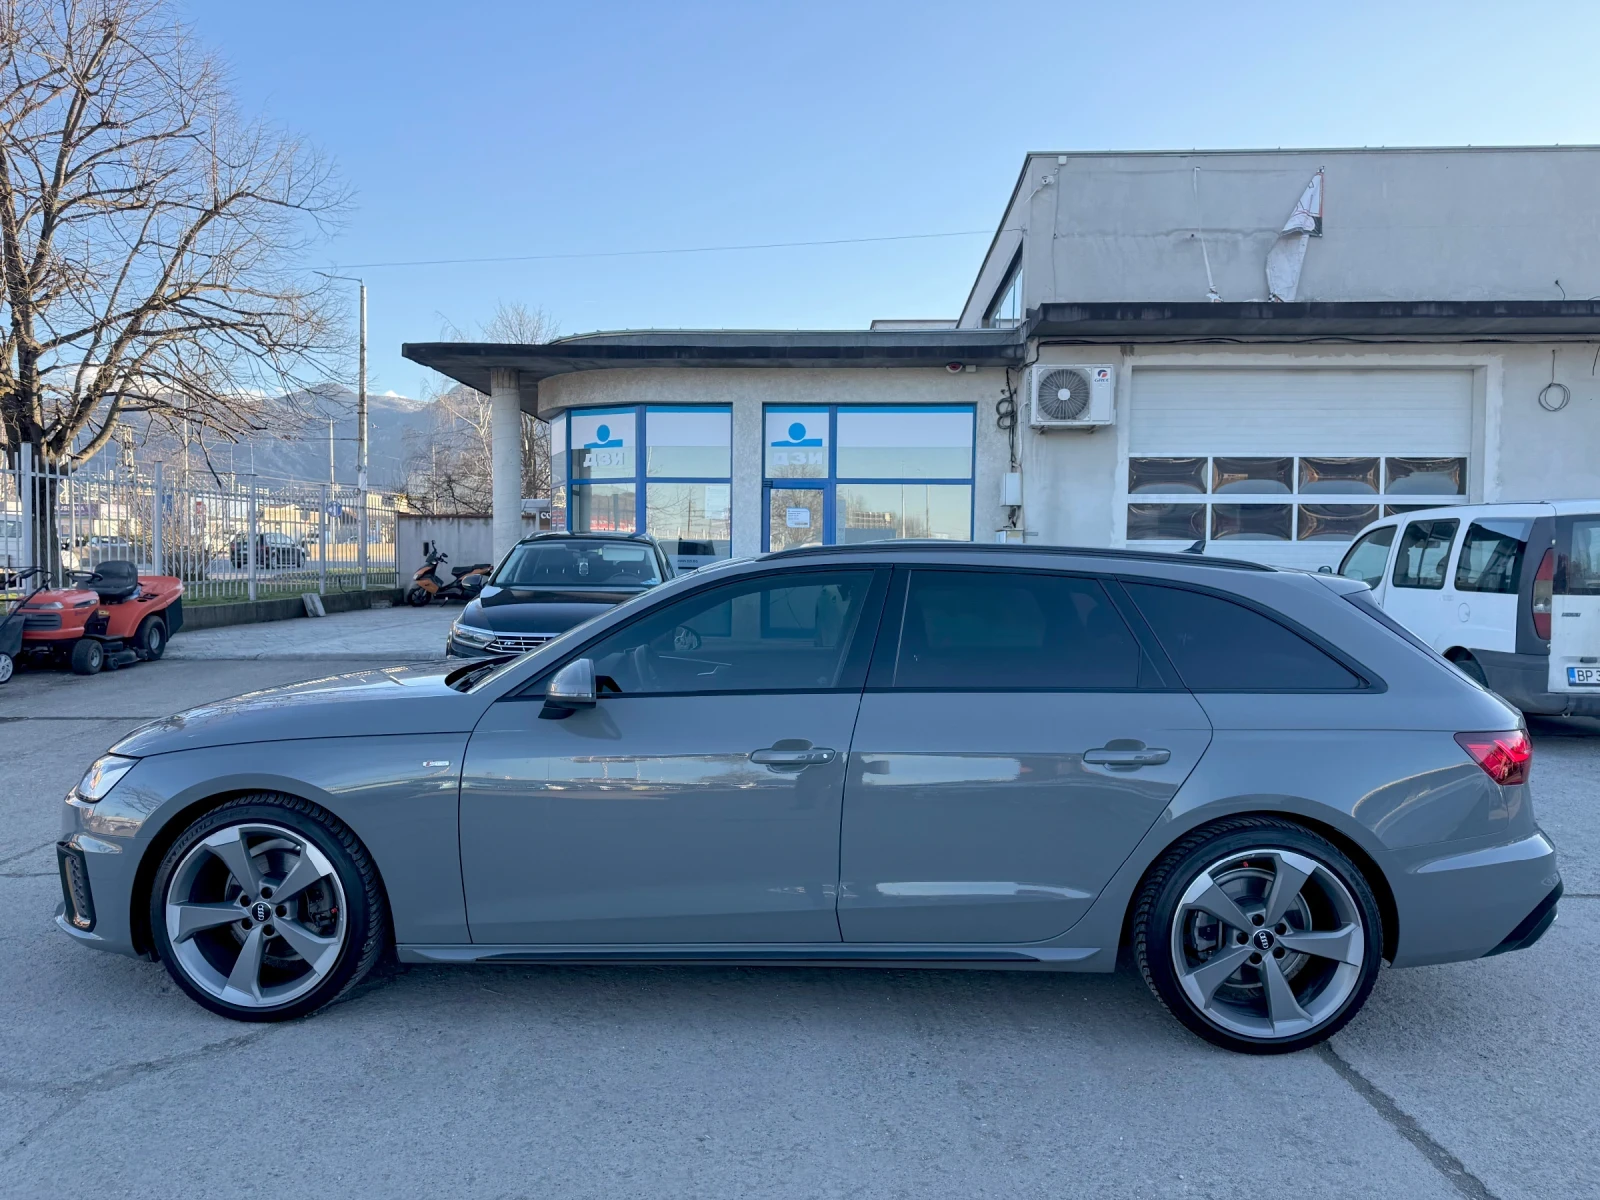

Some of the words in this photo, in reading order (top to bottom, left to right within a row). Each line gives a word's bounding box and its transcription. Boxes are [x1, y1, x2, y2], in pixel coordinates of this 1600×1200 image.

[583, 453, 624, 467] ДЗИ
[772, 452, 823, 466] ДЗИ
[1577, 670, 1593, 682] BP
